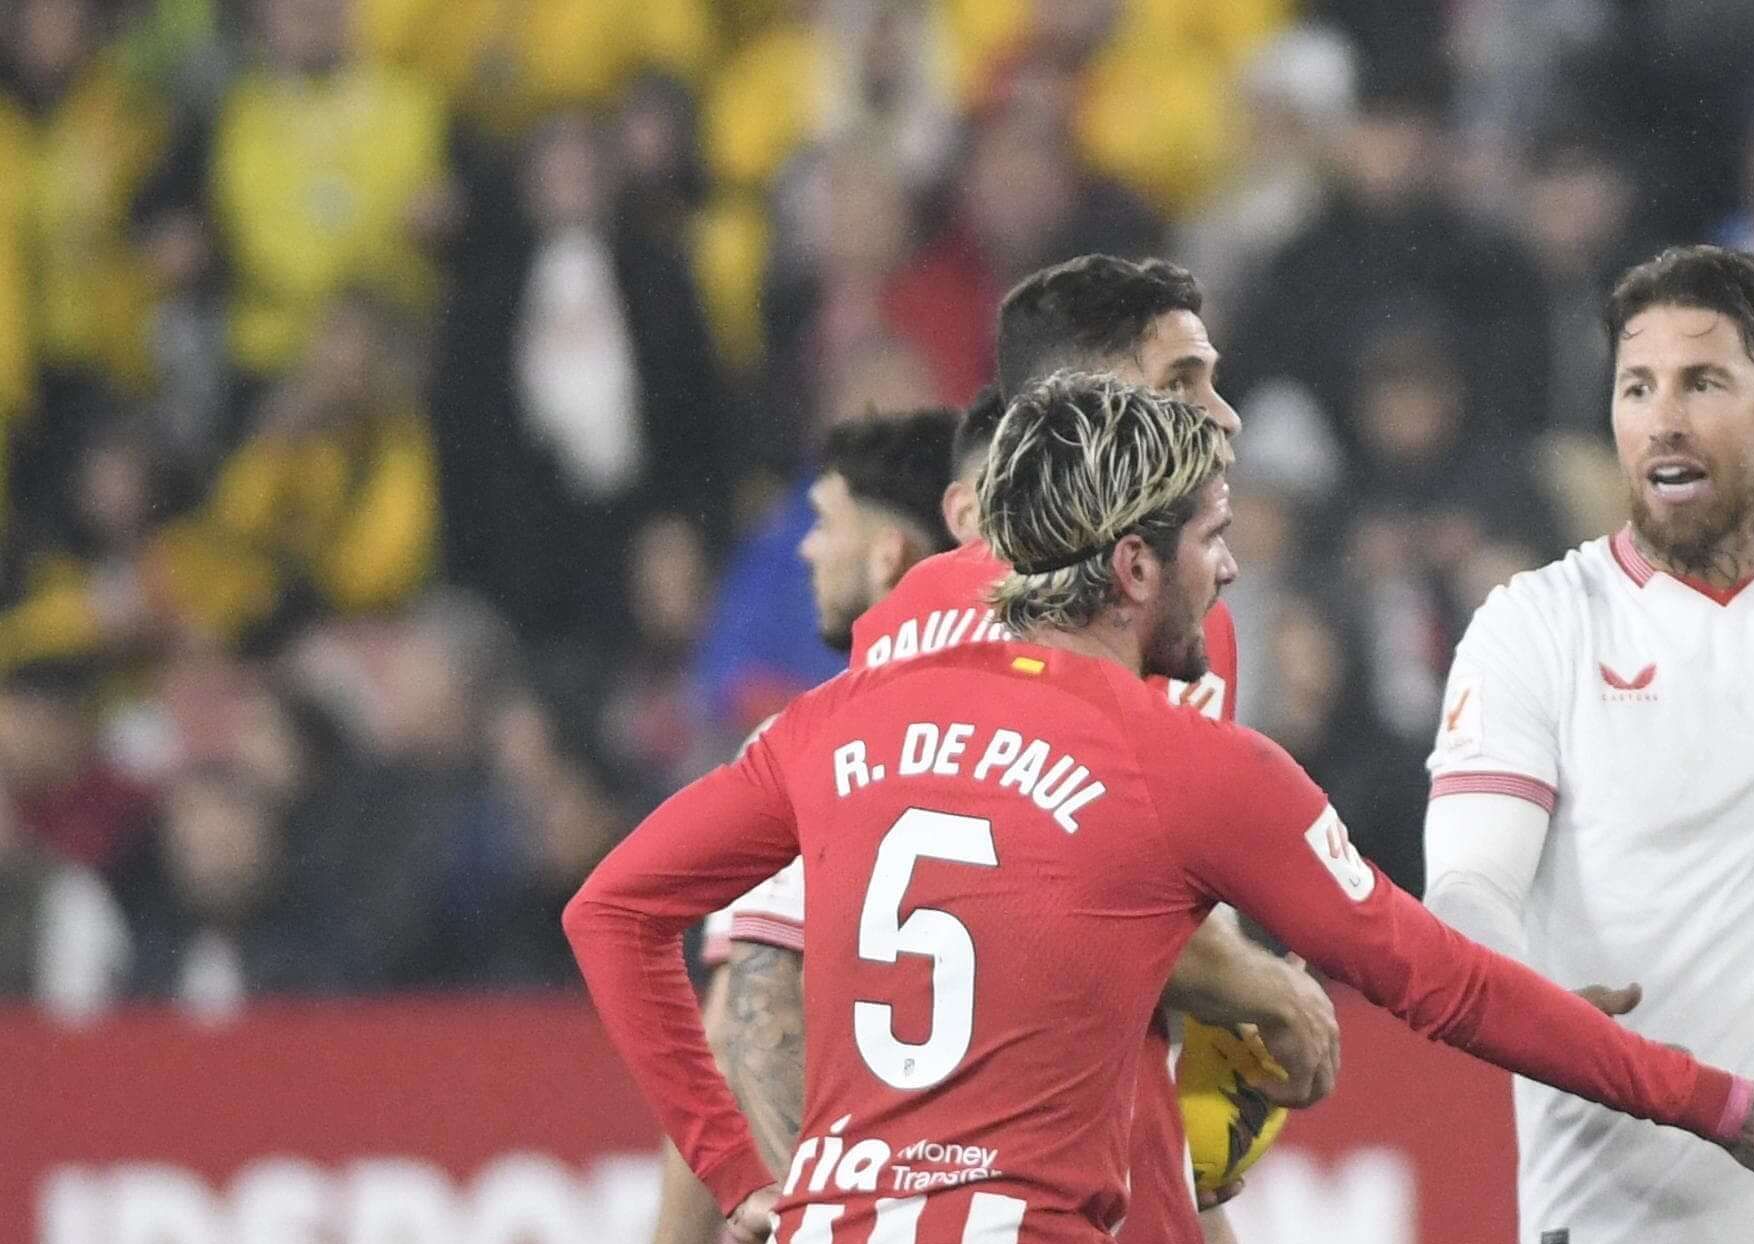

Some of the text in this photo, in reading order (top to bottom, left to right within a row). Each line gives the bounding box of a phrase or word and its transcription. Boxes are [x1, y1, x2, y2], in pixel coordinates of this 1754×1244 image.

[833, 722, 1107, 835] R. DE PAUL
[853, 806, 999, 1091] 5
[897, 1138, 999, 1168] Money
